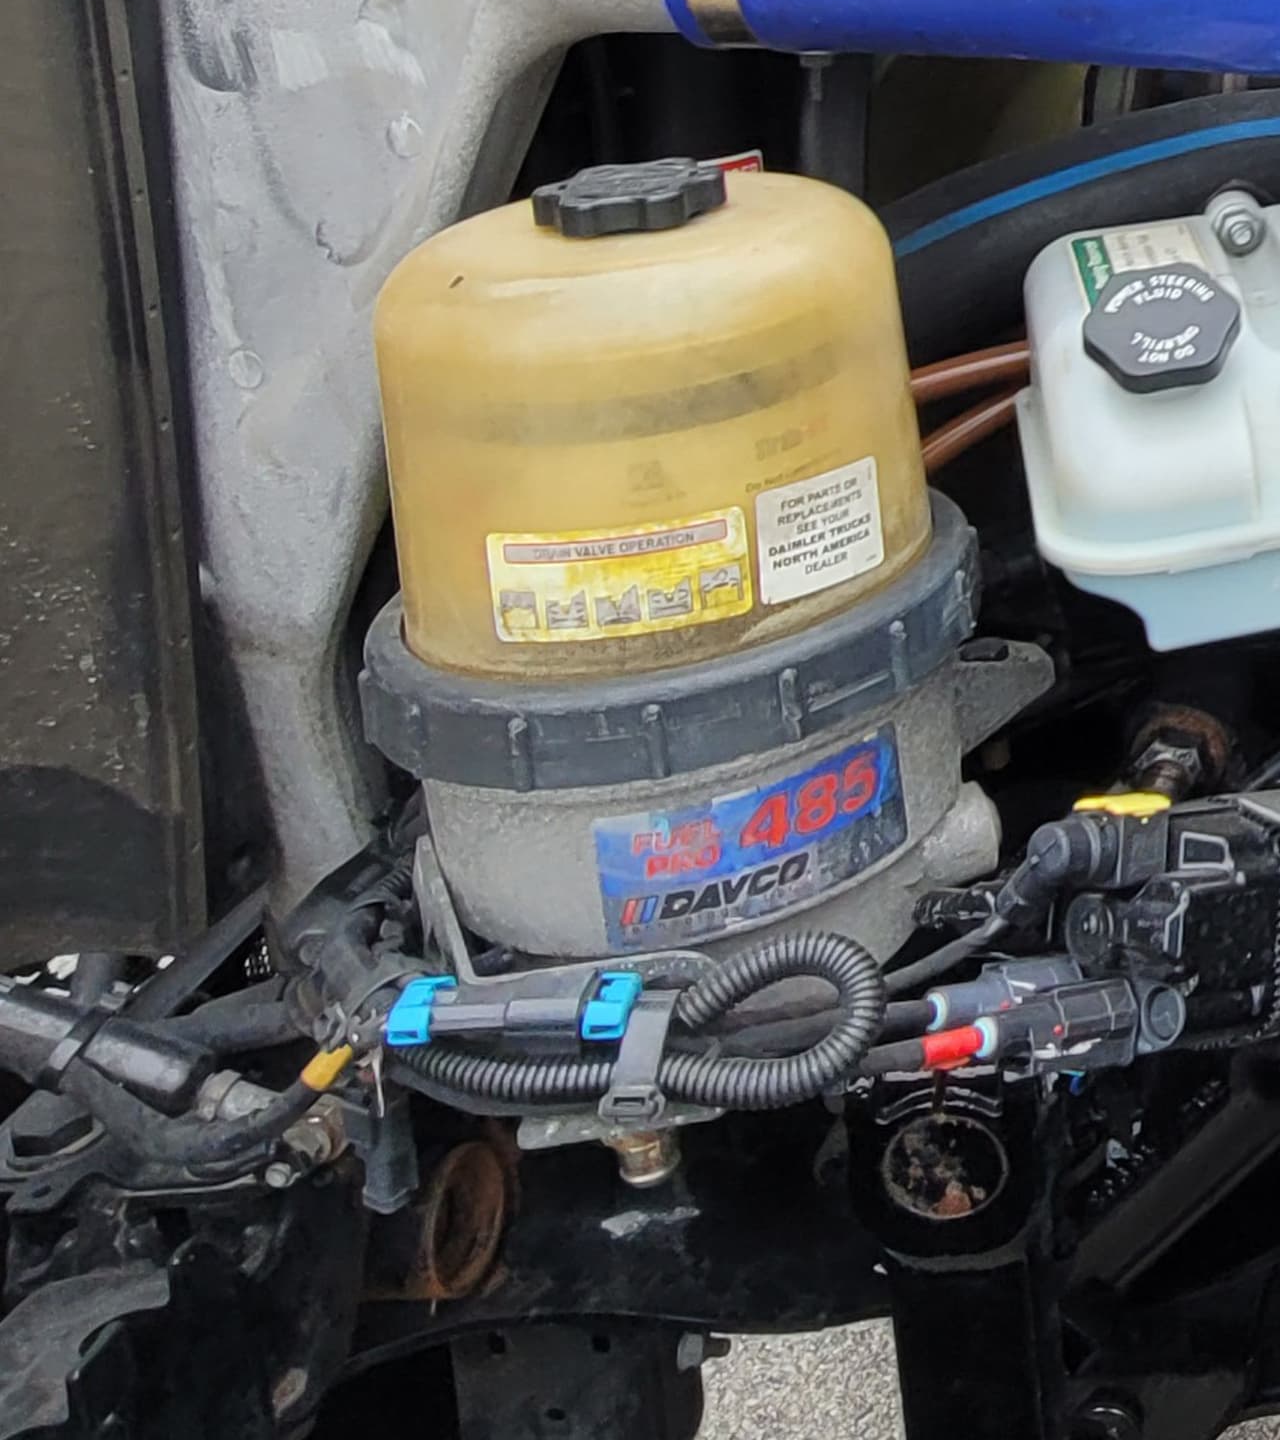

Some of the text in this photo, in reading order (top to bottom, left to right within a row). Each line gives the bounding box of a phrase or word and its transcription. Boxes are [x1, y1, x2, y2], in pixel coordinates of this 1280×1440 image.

[1104, 273, 1215, 313] POWER STEERING
[1133, 286, 1182, 305] FLUID
[1137, 351, 1170, 363] NOT
[776, 489, 863, 527] REPLACEMENTS
[780, 476, 860, 511] FOR PARTS OR
[768, 513, 872, 557] DAIMLER TRUCKS
[796, 508, 850, 533] SEE YOUR
[576, 543, 616, 558] VALVE
[619, 533, 695, 552] OPERATION
[772, 528, 871, 571] NORTH AMERICA
[804, 551, 849, 576] DEALER
[739, 753, 879, 849] 485
[631, 816, 722, 857] FUEL
[644, 842, 723, 878] PRO
[658, 852, 811, 921] DAVCO
